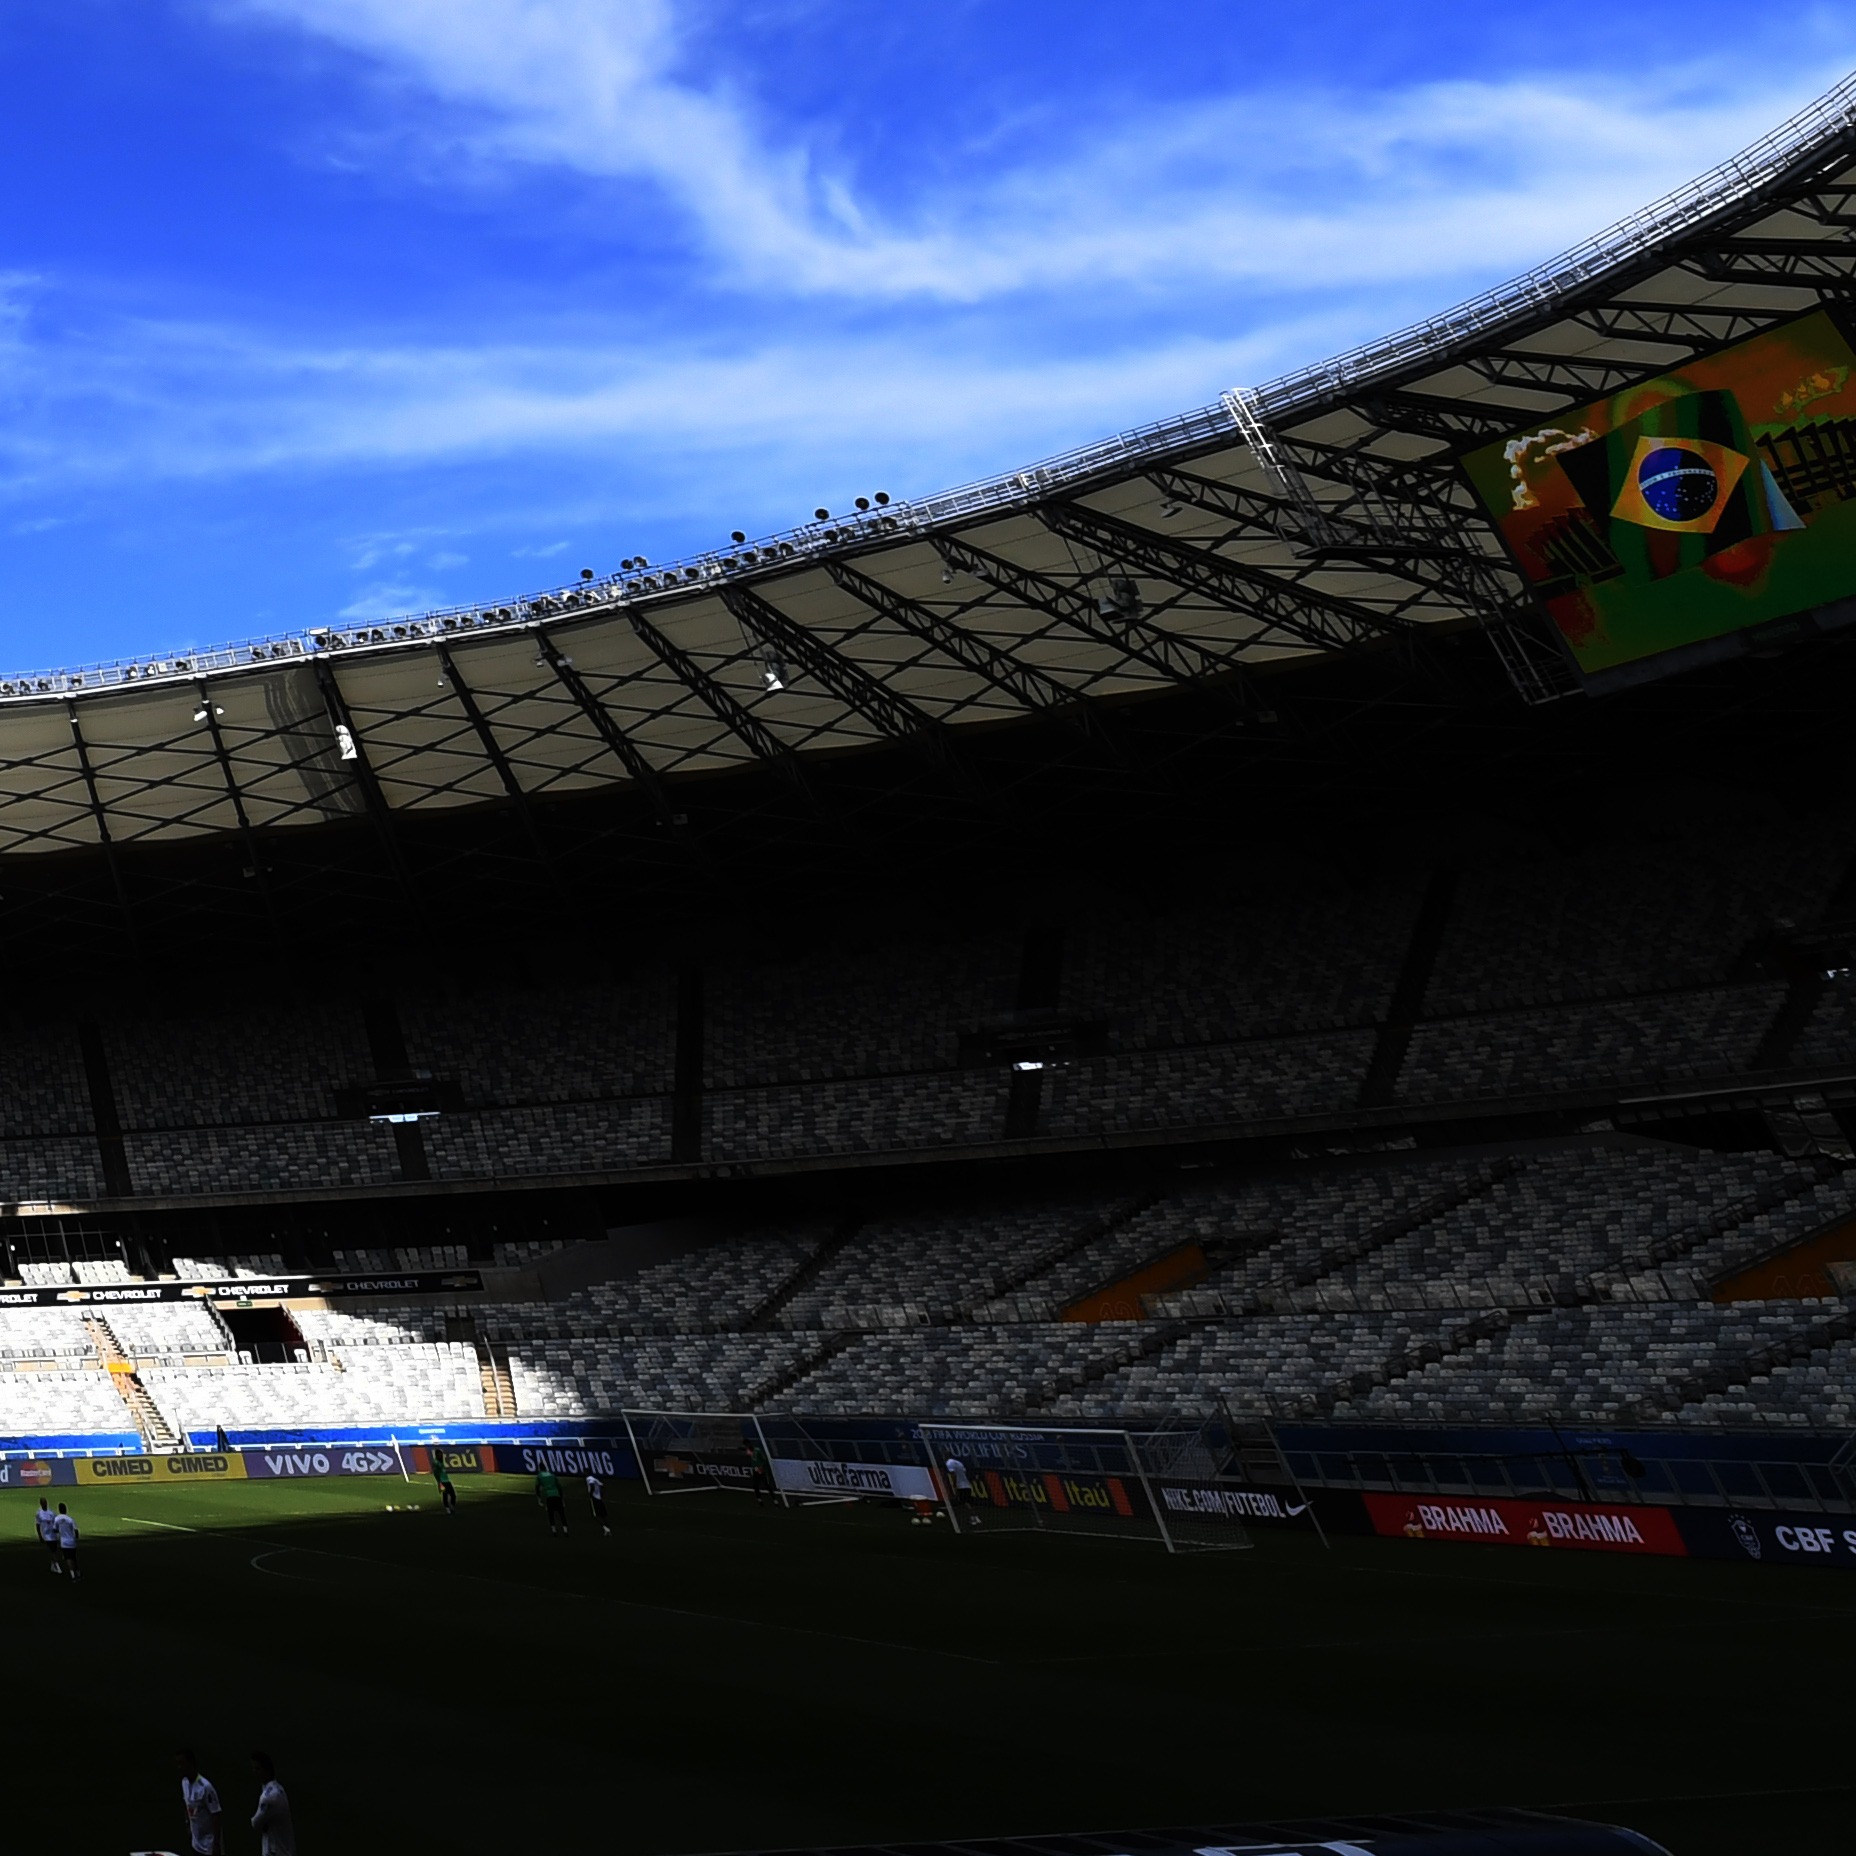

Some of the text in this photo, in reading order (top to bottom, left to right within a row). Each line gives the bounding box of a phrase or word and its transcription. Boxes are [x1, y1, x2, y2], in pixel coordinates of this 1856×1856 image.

[92, 1289, 162, 1301] CHEVROLET
[218, 1284, 289, 1296] CHEVROLET
[346, 1279, 420, 1292] CHEVROLET
[910, 1429, 934, 1440] 208
[92, 1459, 153, 1477] CIMED
[167, 1456, 228, 1474] CIMED
[264, 1454, 330, 1475] VIVO
[522, 1448, 614, 1475] SAMSUNG
[696, 1463, 754, 1478] CHEVROLET
[808, 1462, 893, 1489] ultrafarma
[948, 1472, 989, 1498] Iú
[1003, 1477, 1047, 1504] Itaú
[1064, 1479, 1111, 1508] Itaú
[1161, 1487, 1287, 1519] NIKE.COM/FUTEBOL
[1416, 1504, 1510, 1535] BRAHMA
[1541, 1511, 1645, 1545] BRAHMA
[1774, 1525, 1835, 1554] CBF
